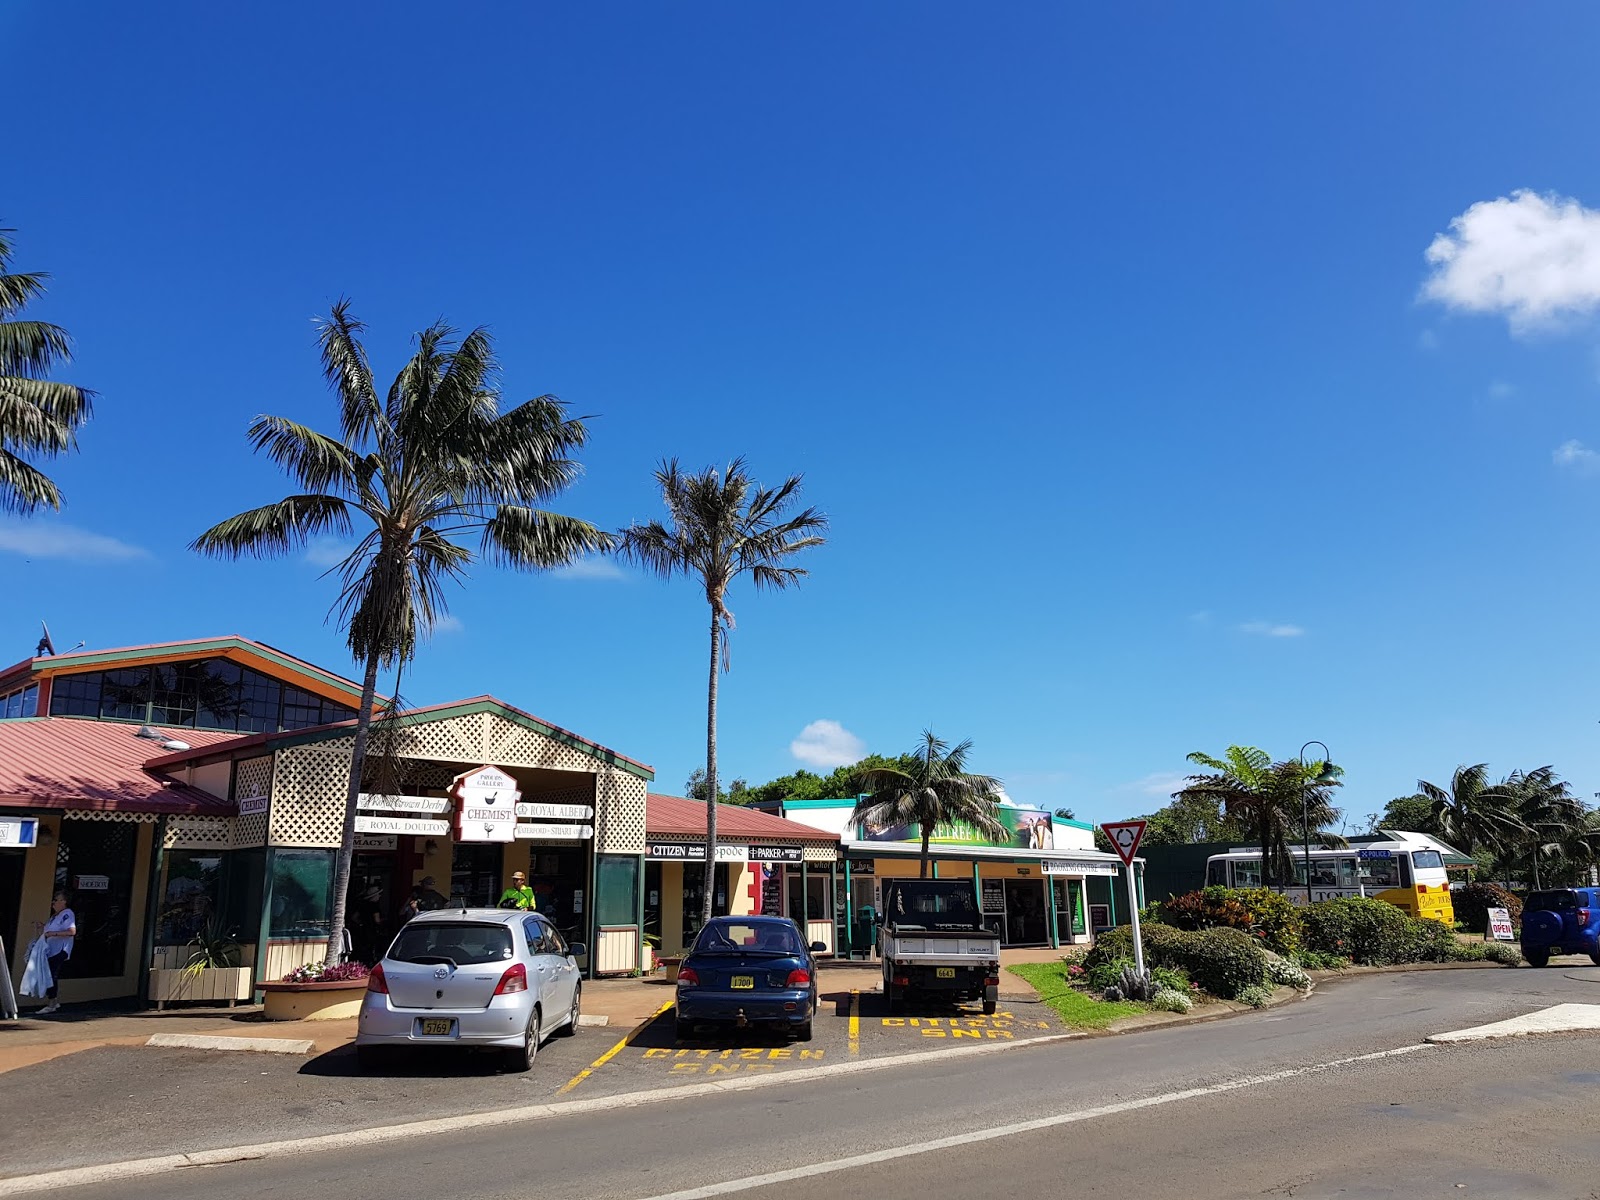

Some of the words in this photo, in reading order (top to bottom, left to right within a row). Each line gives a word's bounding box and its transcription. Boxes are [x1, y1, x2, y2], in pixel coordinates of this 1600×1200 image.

[421, 799, 444, 812] Derby
[467, 809, 512, 820] CHEMIST
[530, 805, 557, 816] ROYAL
[559, 806, 588, 818] ALBERT
[370, 821, 400, 830] ROYAL
[404, 822, 447, 831] DOULTON
[353, 839, 384, 847] MACY
[652, 845, 686, 857] CITIZEN
[757, 848, 781, 859] PARKER
[1049, 860, 1077, 872] BOOKING
[1077, 862, 1099, 873] CENTRE
[1493, 924, 1512, 934] OPEN
[426, 1022, 447, 1034] 5769
[921, 1028, 1015, 1039] SNR
[641, 1048, 825, 1060] CITIZEN
